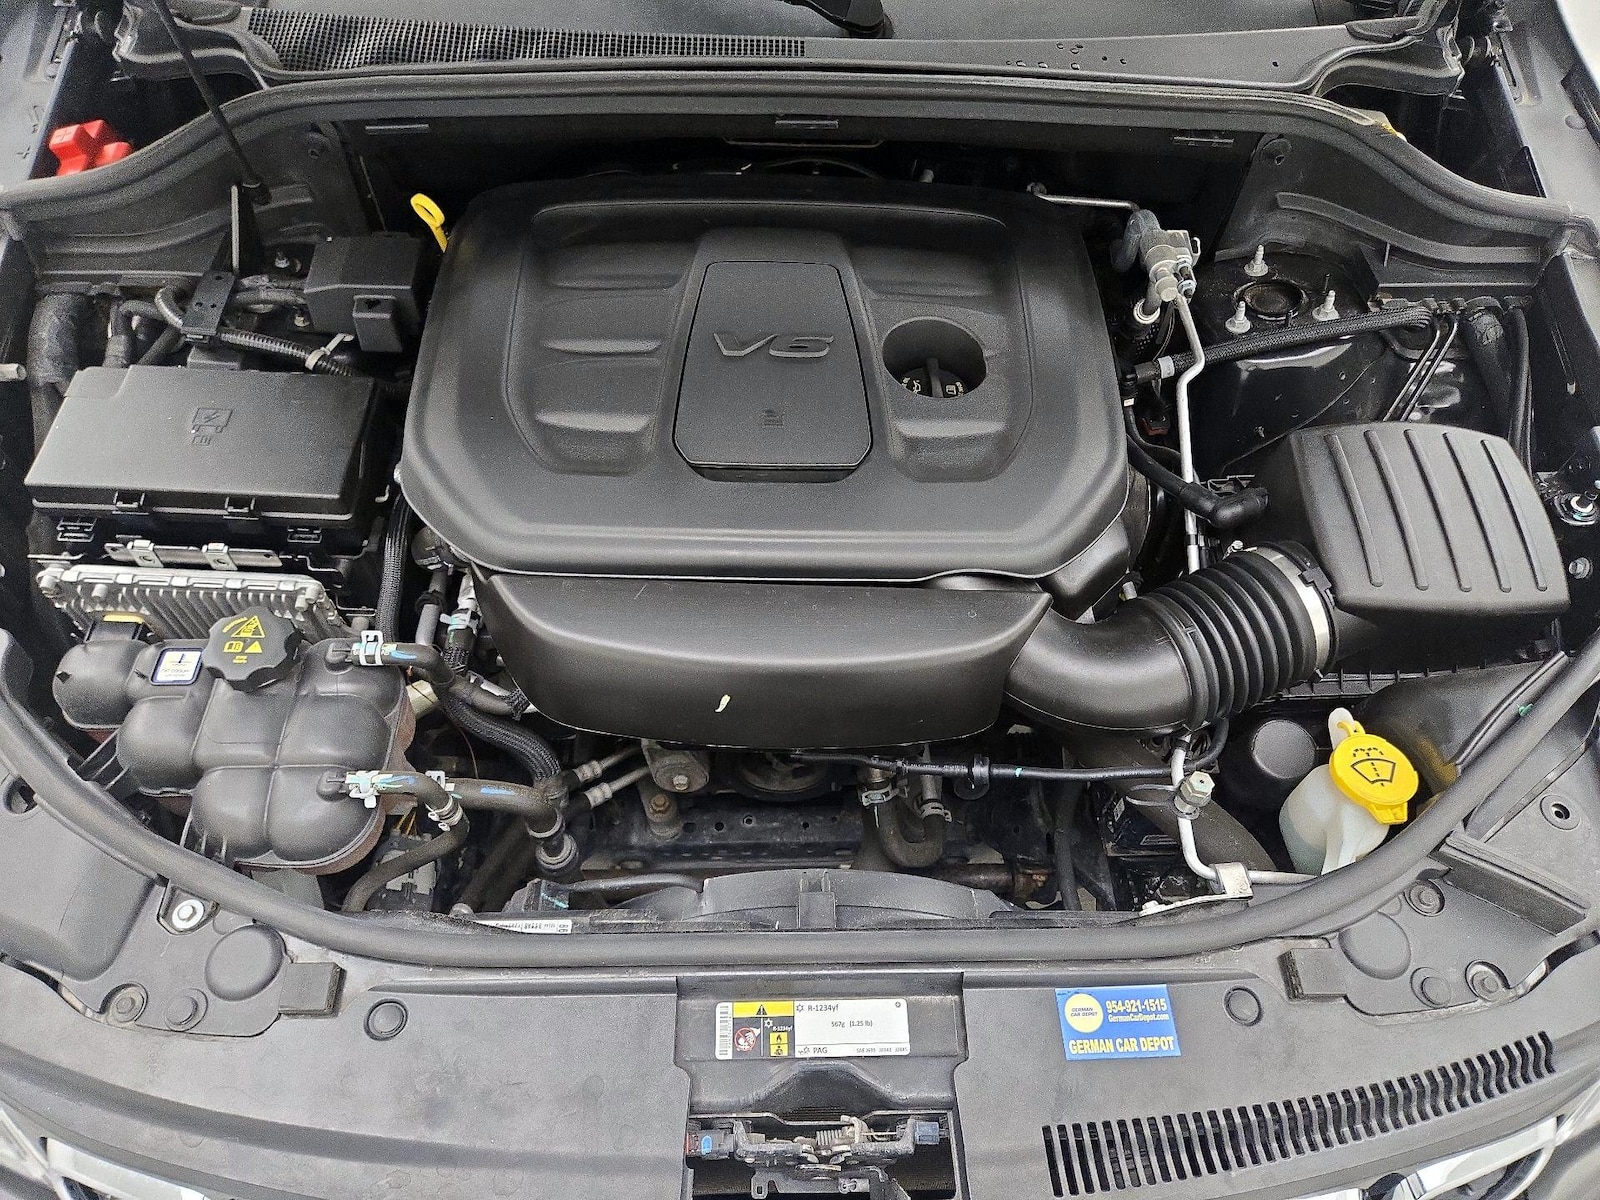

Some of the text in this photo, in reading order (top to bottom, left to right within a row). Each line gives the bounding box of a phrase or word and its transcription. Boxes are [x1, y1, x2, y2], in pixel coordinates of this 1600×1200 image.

[713, 332, 834, 358] V6
[807, 1003, 839, 1012] R-1234yf
[1105, 998, 1168, 1013] 954-921-1515
[1108, 1013, 1170, 1023] GermanCarDepot.com
[831, 1020, 846, 1028] 567g
[849, 1020, 864, 1028] (1.25
[813, 1046, 828, 1054] PAG
[1068, 1036, 1175, 1055] GERMAN CAR DEPOT
